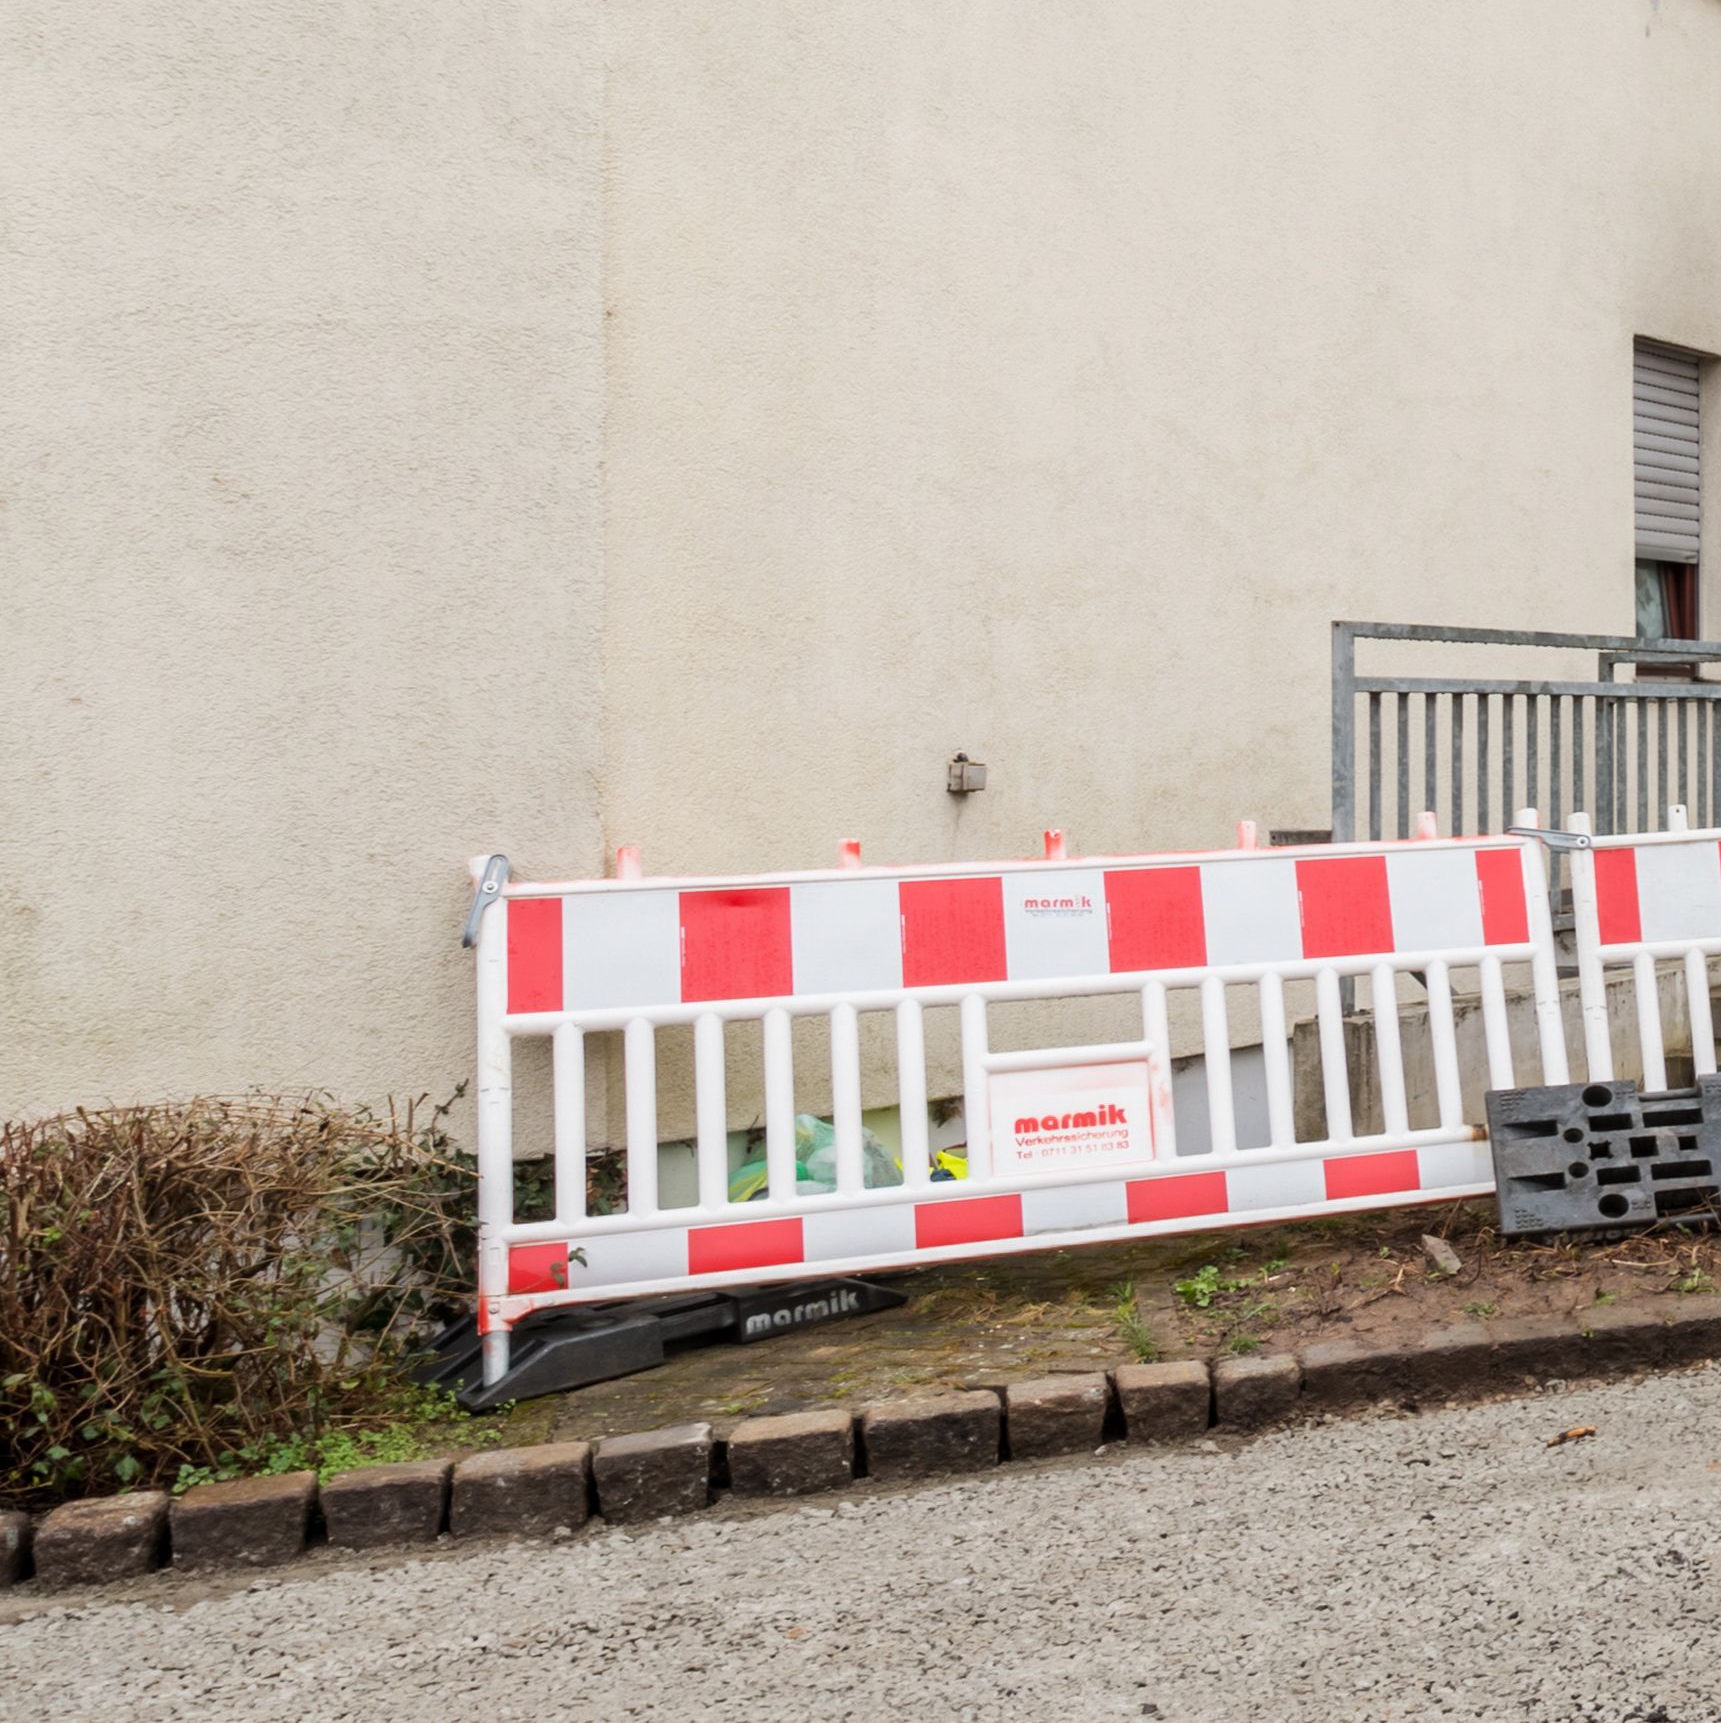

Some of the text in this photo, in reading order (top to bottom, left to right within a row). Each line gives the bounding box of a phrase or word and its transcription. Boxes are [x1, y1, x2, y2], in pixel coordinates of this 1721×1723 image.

[1014, 1103, 1128, 1135] marmik
[1015, 1128, 1129, 1147] Verkehrssicherung
[1041, 1147, 1067, 1157] 0711
[1070, 1145, 1083, 1155] 31
[1086, 1143, 1098, 1153] 51
[746, 1289, 859, 1334] marmik
